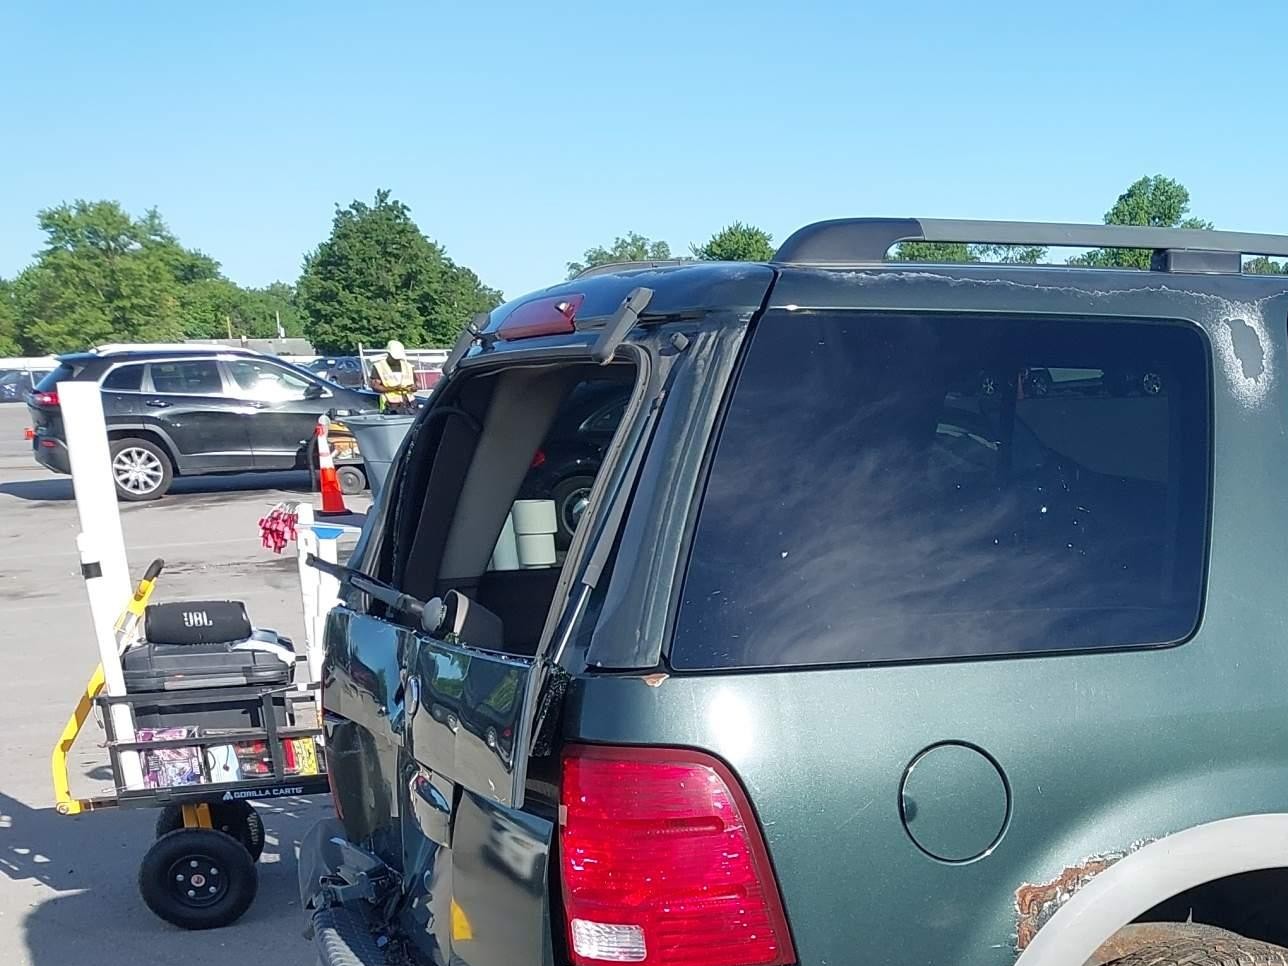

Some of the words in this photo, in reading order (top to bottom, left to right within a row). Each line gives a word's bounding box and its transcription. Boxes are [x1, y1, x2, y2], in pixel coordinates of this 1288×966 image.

[182, 611, 213, 627] JBL
[233, 790, 271, 799] GORILLA
[272, 787, 303, 796] CARTS
